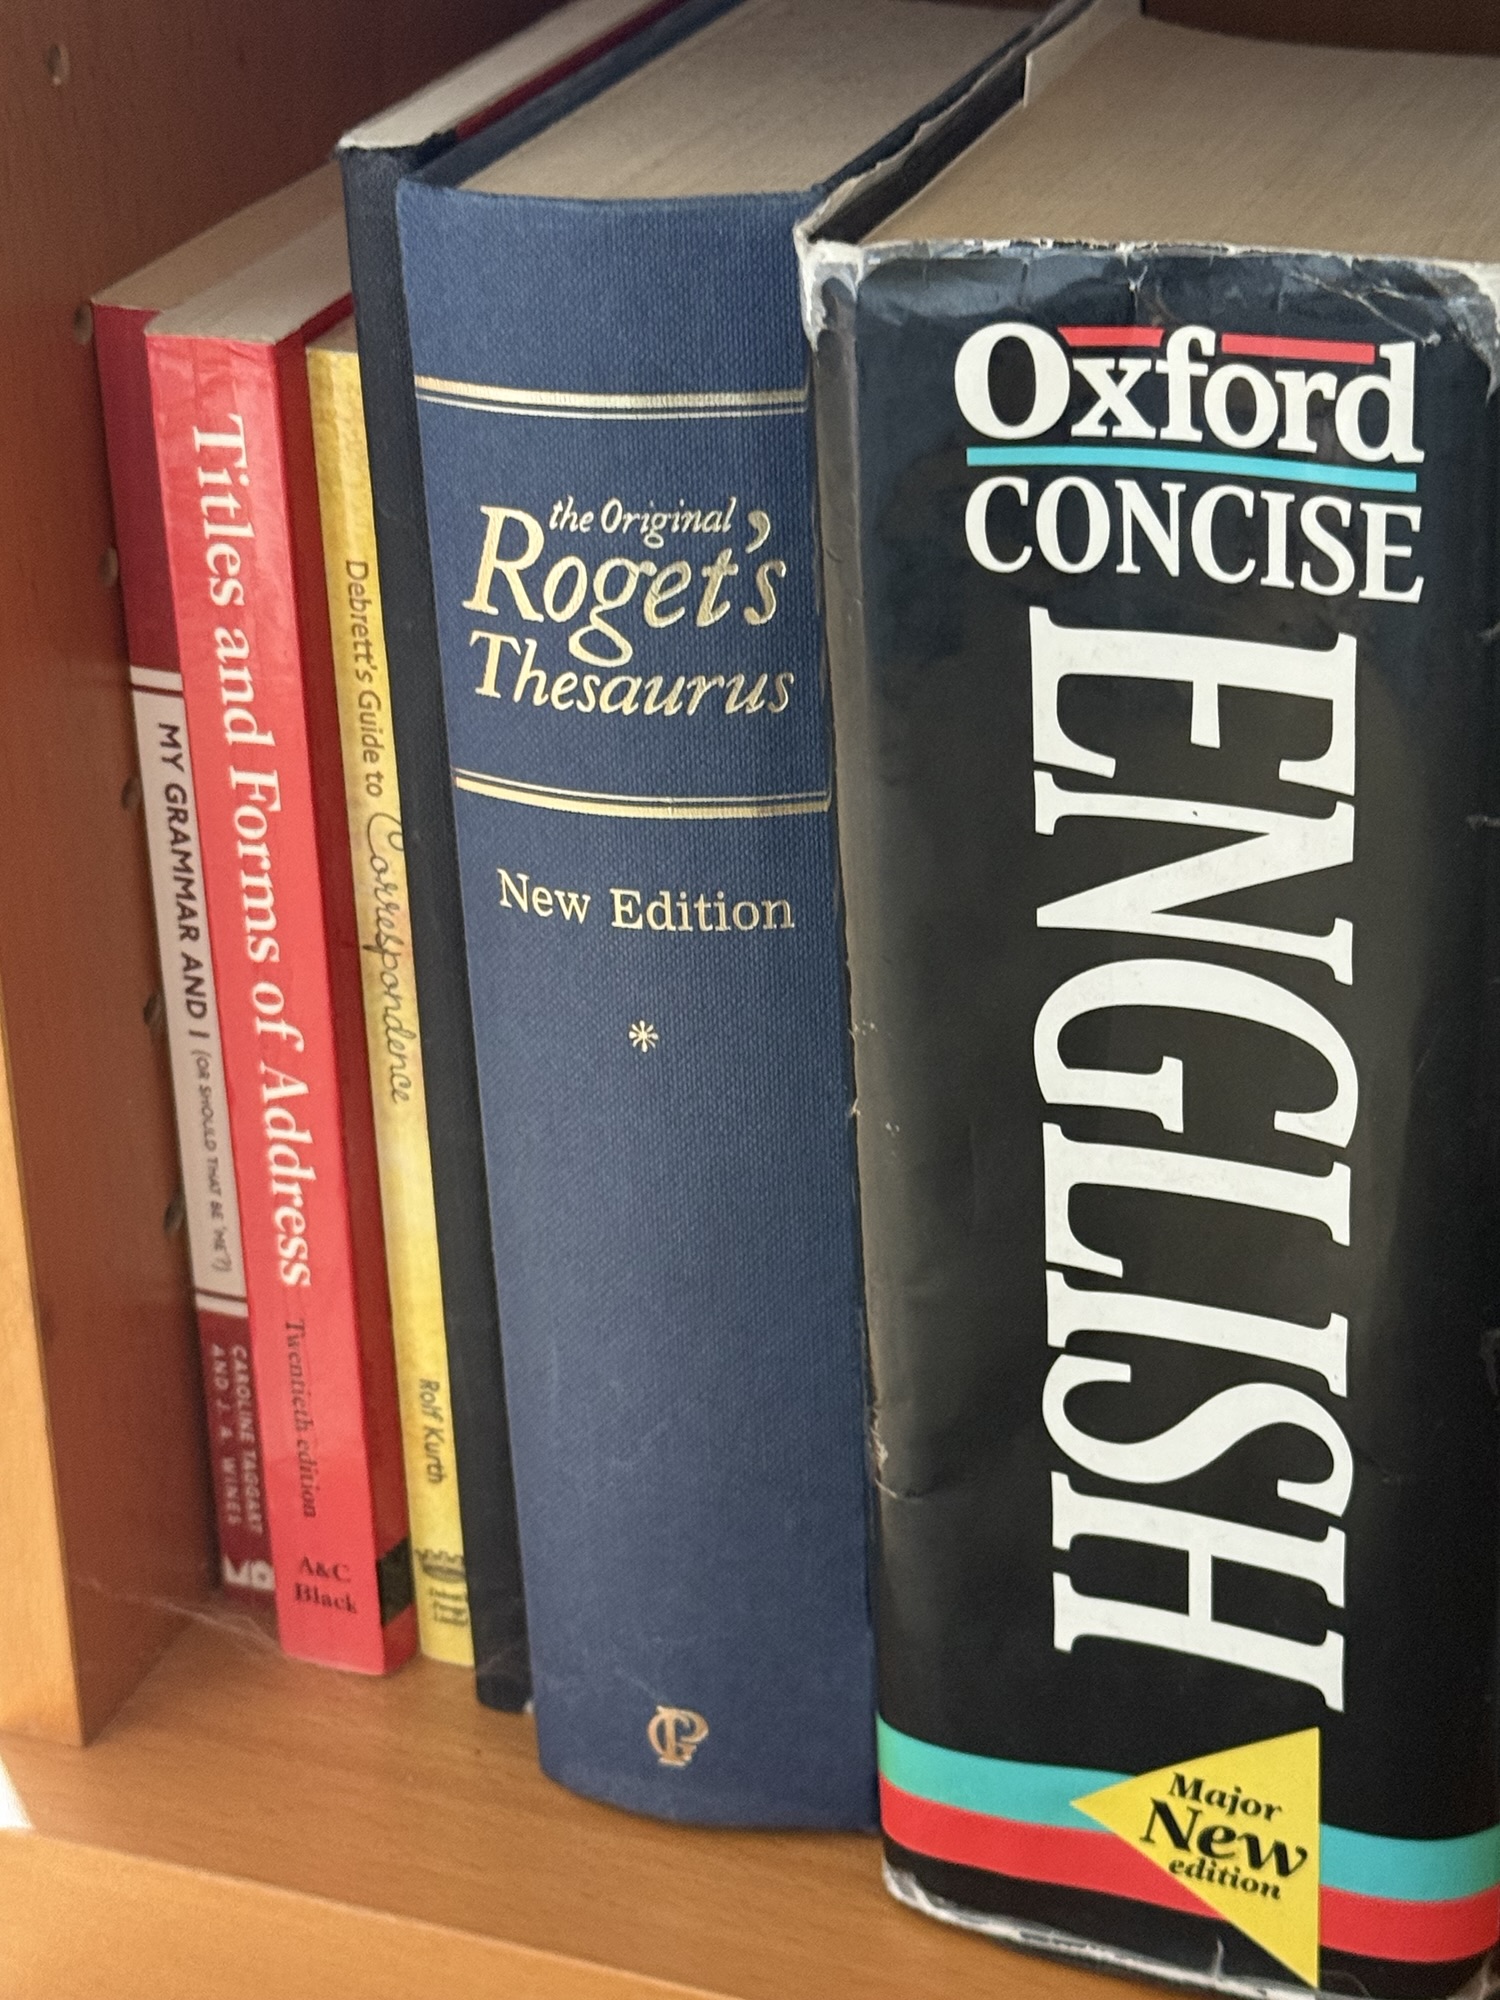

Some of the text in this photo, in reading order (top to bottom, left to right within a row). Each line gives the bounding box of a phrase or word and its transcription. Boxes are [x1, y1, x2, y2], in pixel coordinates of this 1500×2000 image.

[954, 321, 1425, 464] Oxford
[549, 496, 737, 549] the Original
[965, 475, 1424, 603] CONCISE
[462, 505, 786, 667] Roget's
[470, 630, 794, 716] Thesaurus
[158, 722, 184, 772] MY
[164, 782, 200, 941] GRAMMAR
[192, 412, 317, 1287] Titles and Forms of Address
[345, 559, 417, 1104] Debrett's Guide to Correspondence
[497, 868, 795, 932] New Edition
[181, 953, 208, 1020] AND
[188, 1029, 210, 1039] I
[191, 1049, 212, 1080] (OR
[199, 1083, 218, 1151] SHOULD
[207, 1157, 221, 1196] THAT
[1029, 605, 1359, 1713] ENGLISH
[210, 1201, 224, 1219] BE
[212, 1343, 229, 1390] AND
[232, 1344, 255, 1443] CAROLINE
[285, 1318, 320, 1517] Twentieth edition
[419, 1378, 447, 1484] Rolf Kurth
[294, 1582, 357, 1614] Black
[300, 1556, 352, 1583] A&C
[1169, 1772, 1283, 1822] Major
[1139, 1798, 1308, 1878] New
[1168, 1856, 1283, 1901] edition
